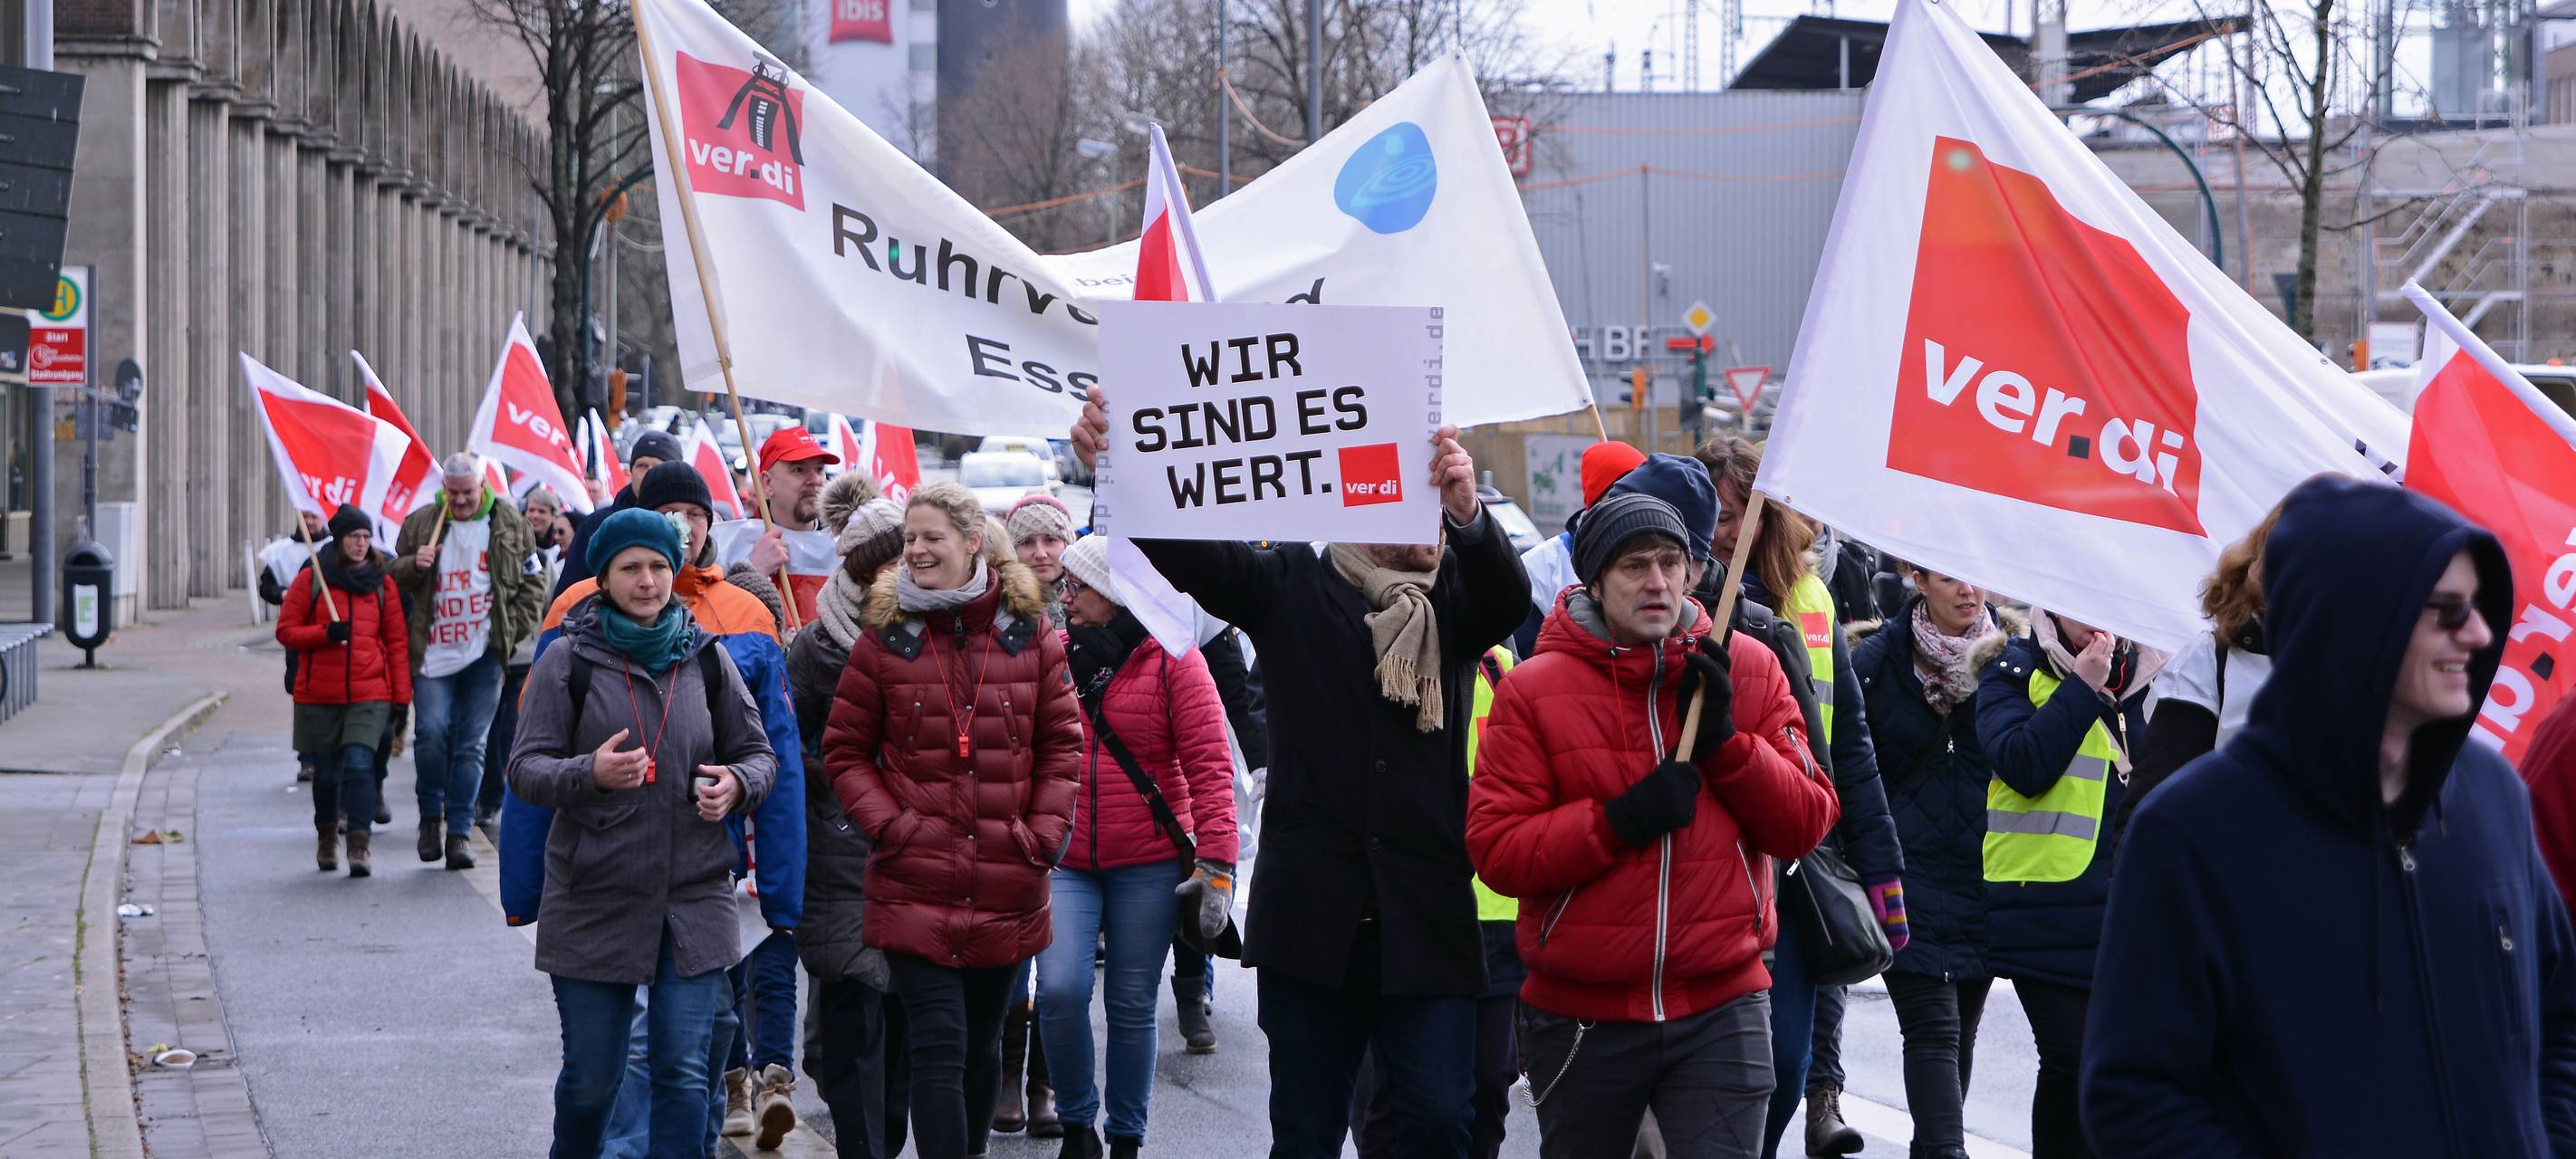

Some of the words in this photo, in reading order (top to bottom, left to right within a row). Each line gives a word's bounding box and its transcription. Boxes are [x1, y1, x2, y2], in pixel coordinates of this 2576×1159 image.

[839, 0, 885, 22] ibis
[688, 138, 794, 196] ver.di
[1181, 331, 1302, 388] WIR
[1132, 395, 1277, 453] SIND
[1295, 385, 1369, 436] ES
[1924, 338, 2185, 498] ver.di
[1166, 448, 1333, 510] WERT.
[1345, 479, 1398, 495] ver.di
